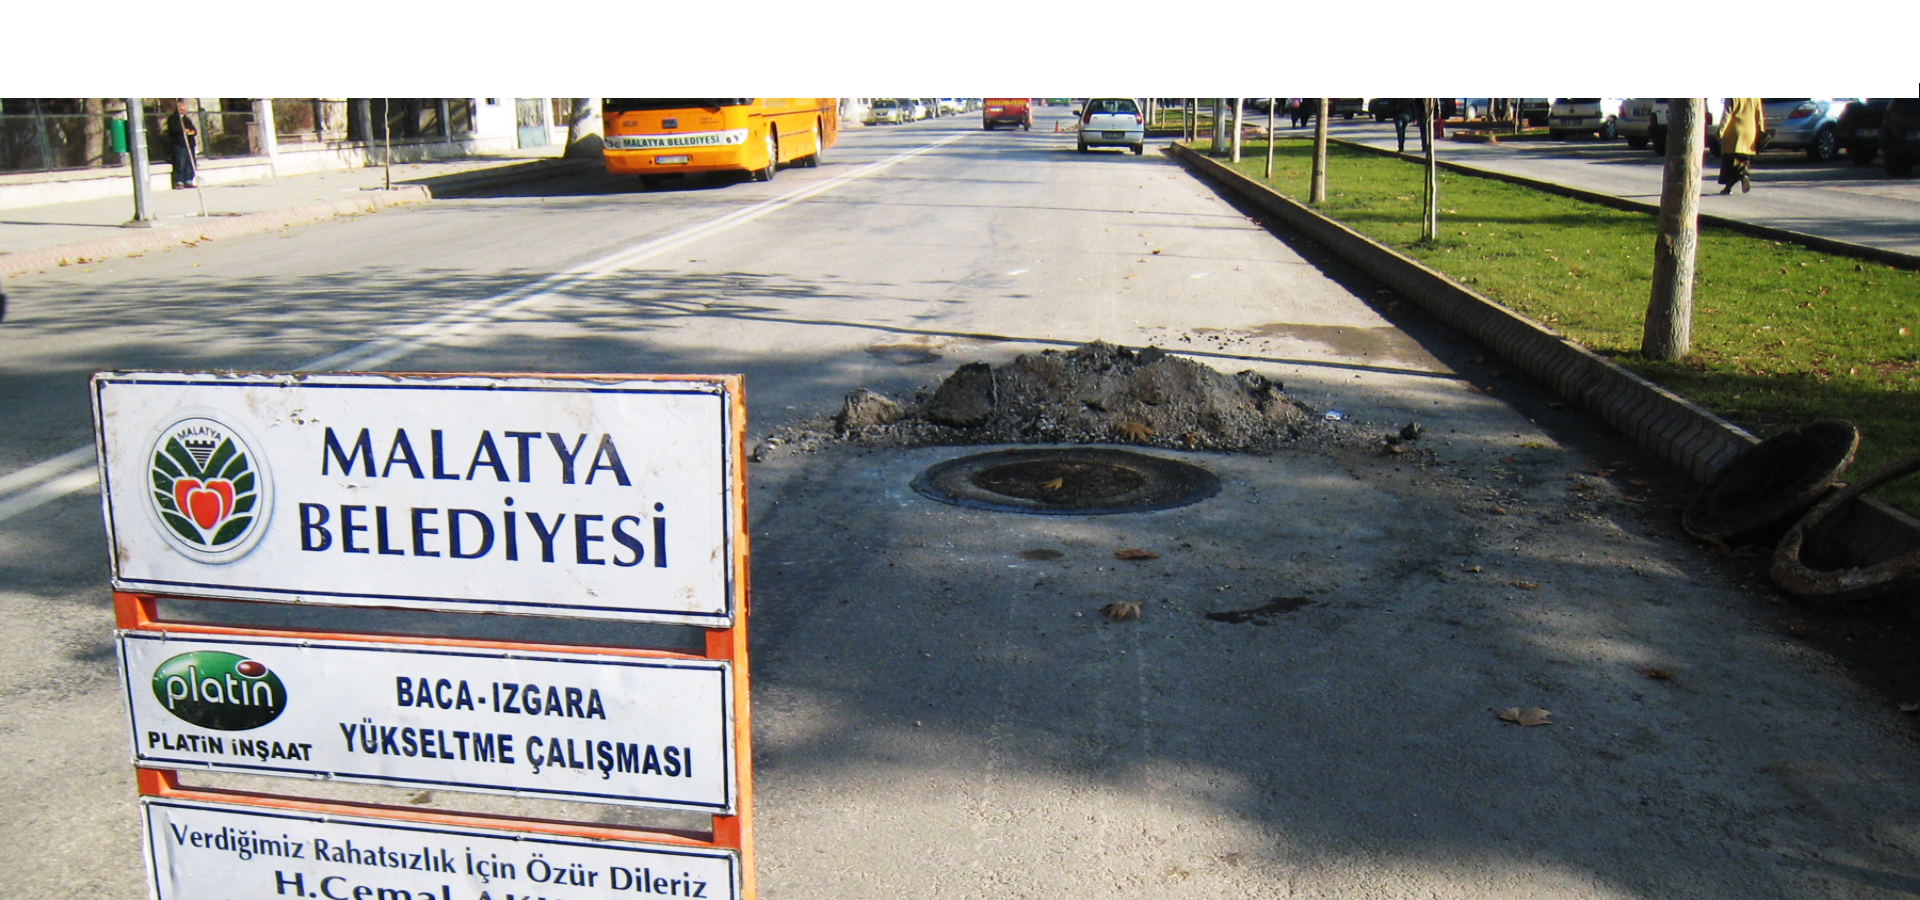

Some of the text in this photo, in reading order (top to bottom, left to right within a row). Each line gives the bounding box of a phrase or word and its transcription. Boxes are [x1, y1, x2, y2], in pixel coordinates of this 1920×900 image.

[623, 138, 665, 148] MALATYA
[177, 426, 221, 441] MALATYA
[321, 426, 632, 487] MALATYA
[298, 496, 668, 569] BELEDİYESİ
[166, 659, 273, 709] platin
[339, 717, 692, 780] YÜKSELTME ÇALIŞMASI
[170, 823, 708, 899] Verdiğimiz Rahatsızlık İçin Özür Dileriz
